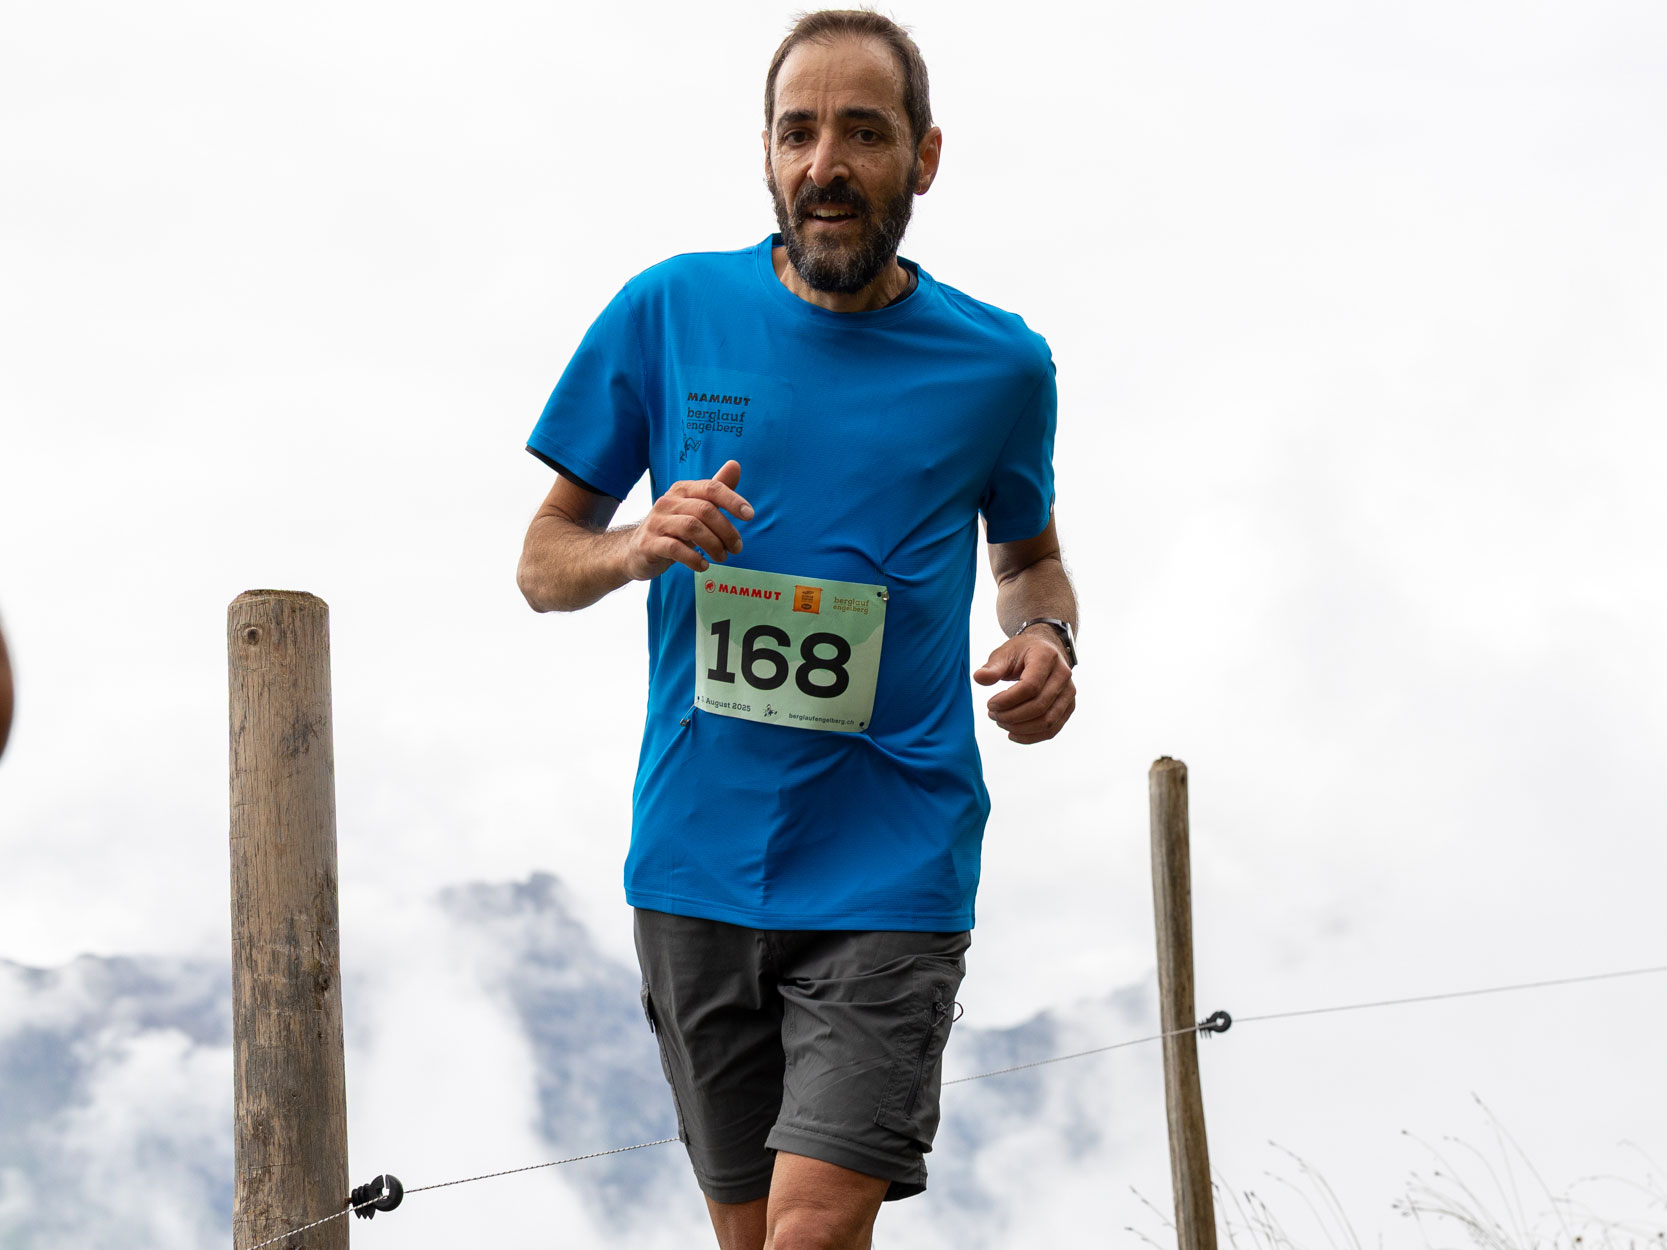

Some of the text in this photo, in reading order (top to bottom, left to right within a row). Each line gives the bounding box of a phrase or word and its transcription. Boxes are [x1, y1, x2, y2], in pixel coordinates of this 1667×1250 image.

[687, 392, 751, 406] MAMMUT
[687, 407, 746, 423] berglauf
[686, 421, 744, 437] engelberg
[718, 583, 782, 601] MAMMUT
[833, 596, 870, 607] berglauf
[833, 604, 869, 615] engelberg
[707, 618, 852, 699] 168
[705, 697, 731, 709] August
[731, 702, 751, 712] 2025
[788, 713, 855, 725] berglaufengelberg.ch
